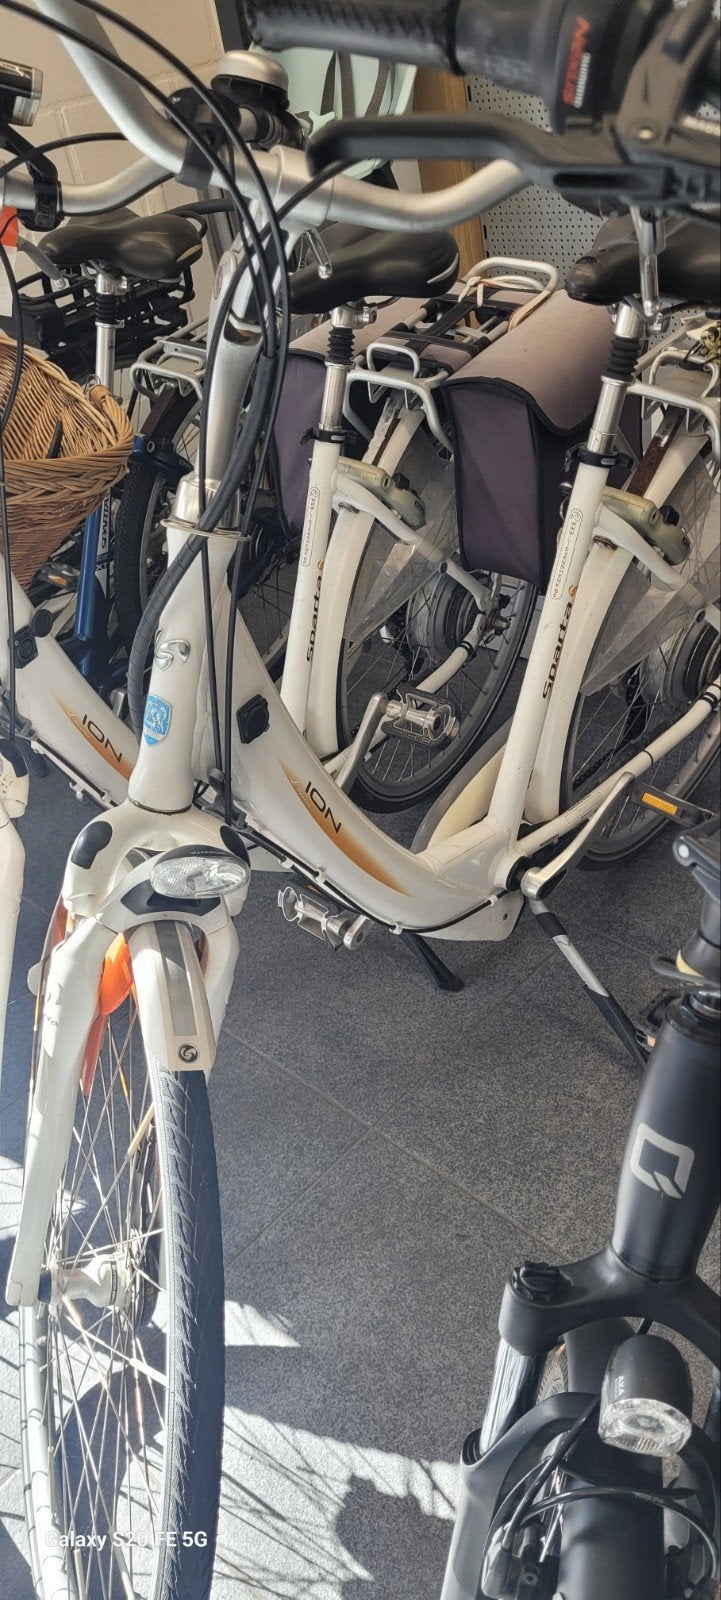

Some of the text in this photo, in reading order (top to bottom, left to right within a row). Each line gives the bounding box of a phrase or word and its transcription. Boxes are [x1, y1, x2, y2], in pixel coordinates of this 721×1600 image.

[306, 574, 323, 663] Sparta
[542, 601, 574, 700] Sparta
[83, 713, 123, 763] ION
[306, 781, 342, 834] ION
